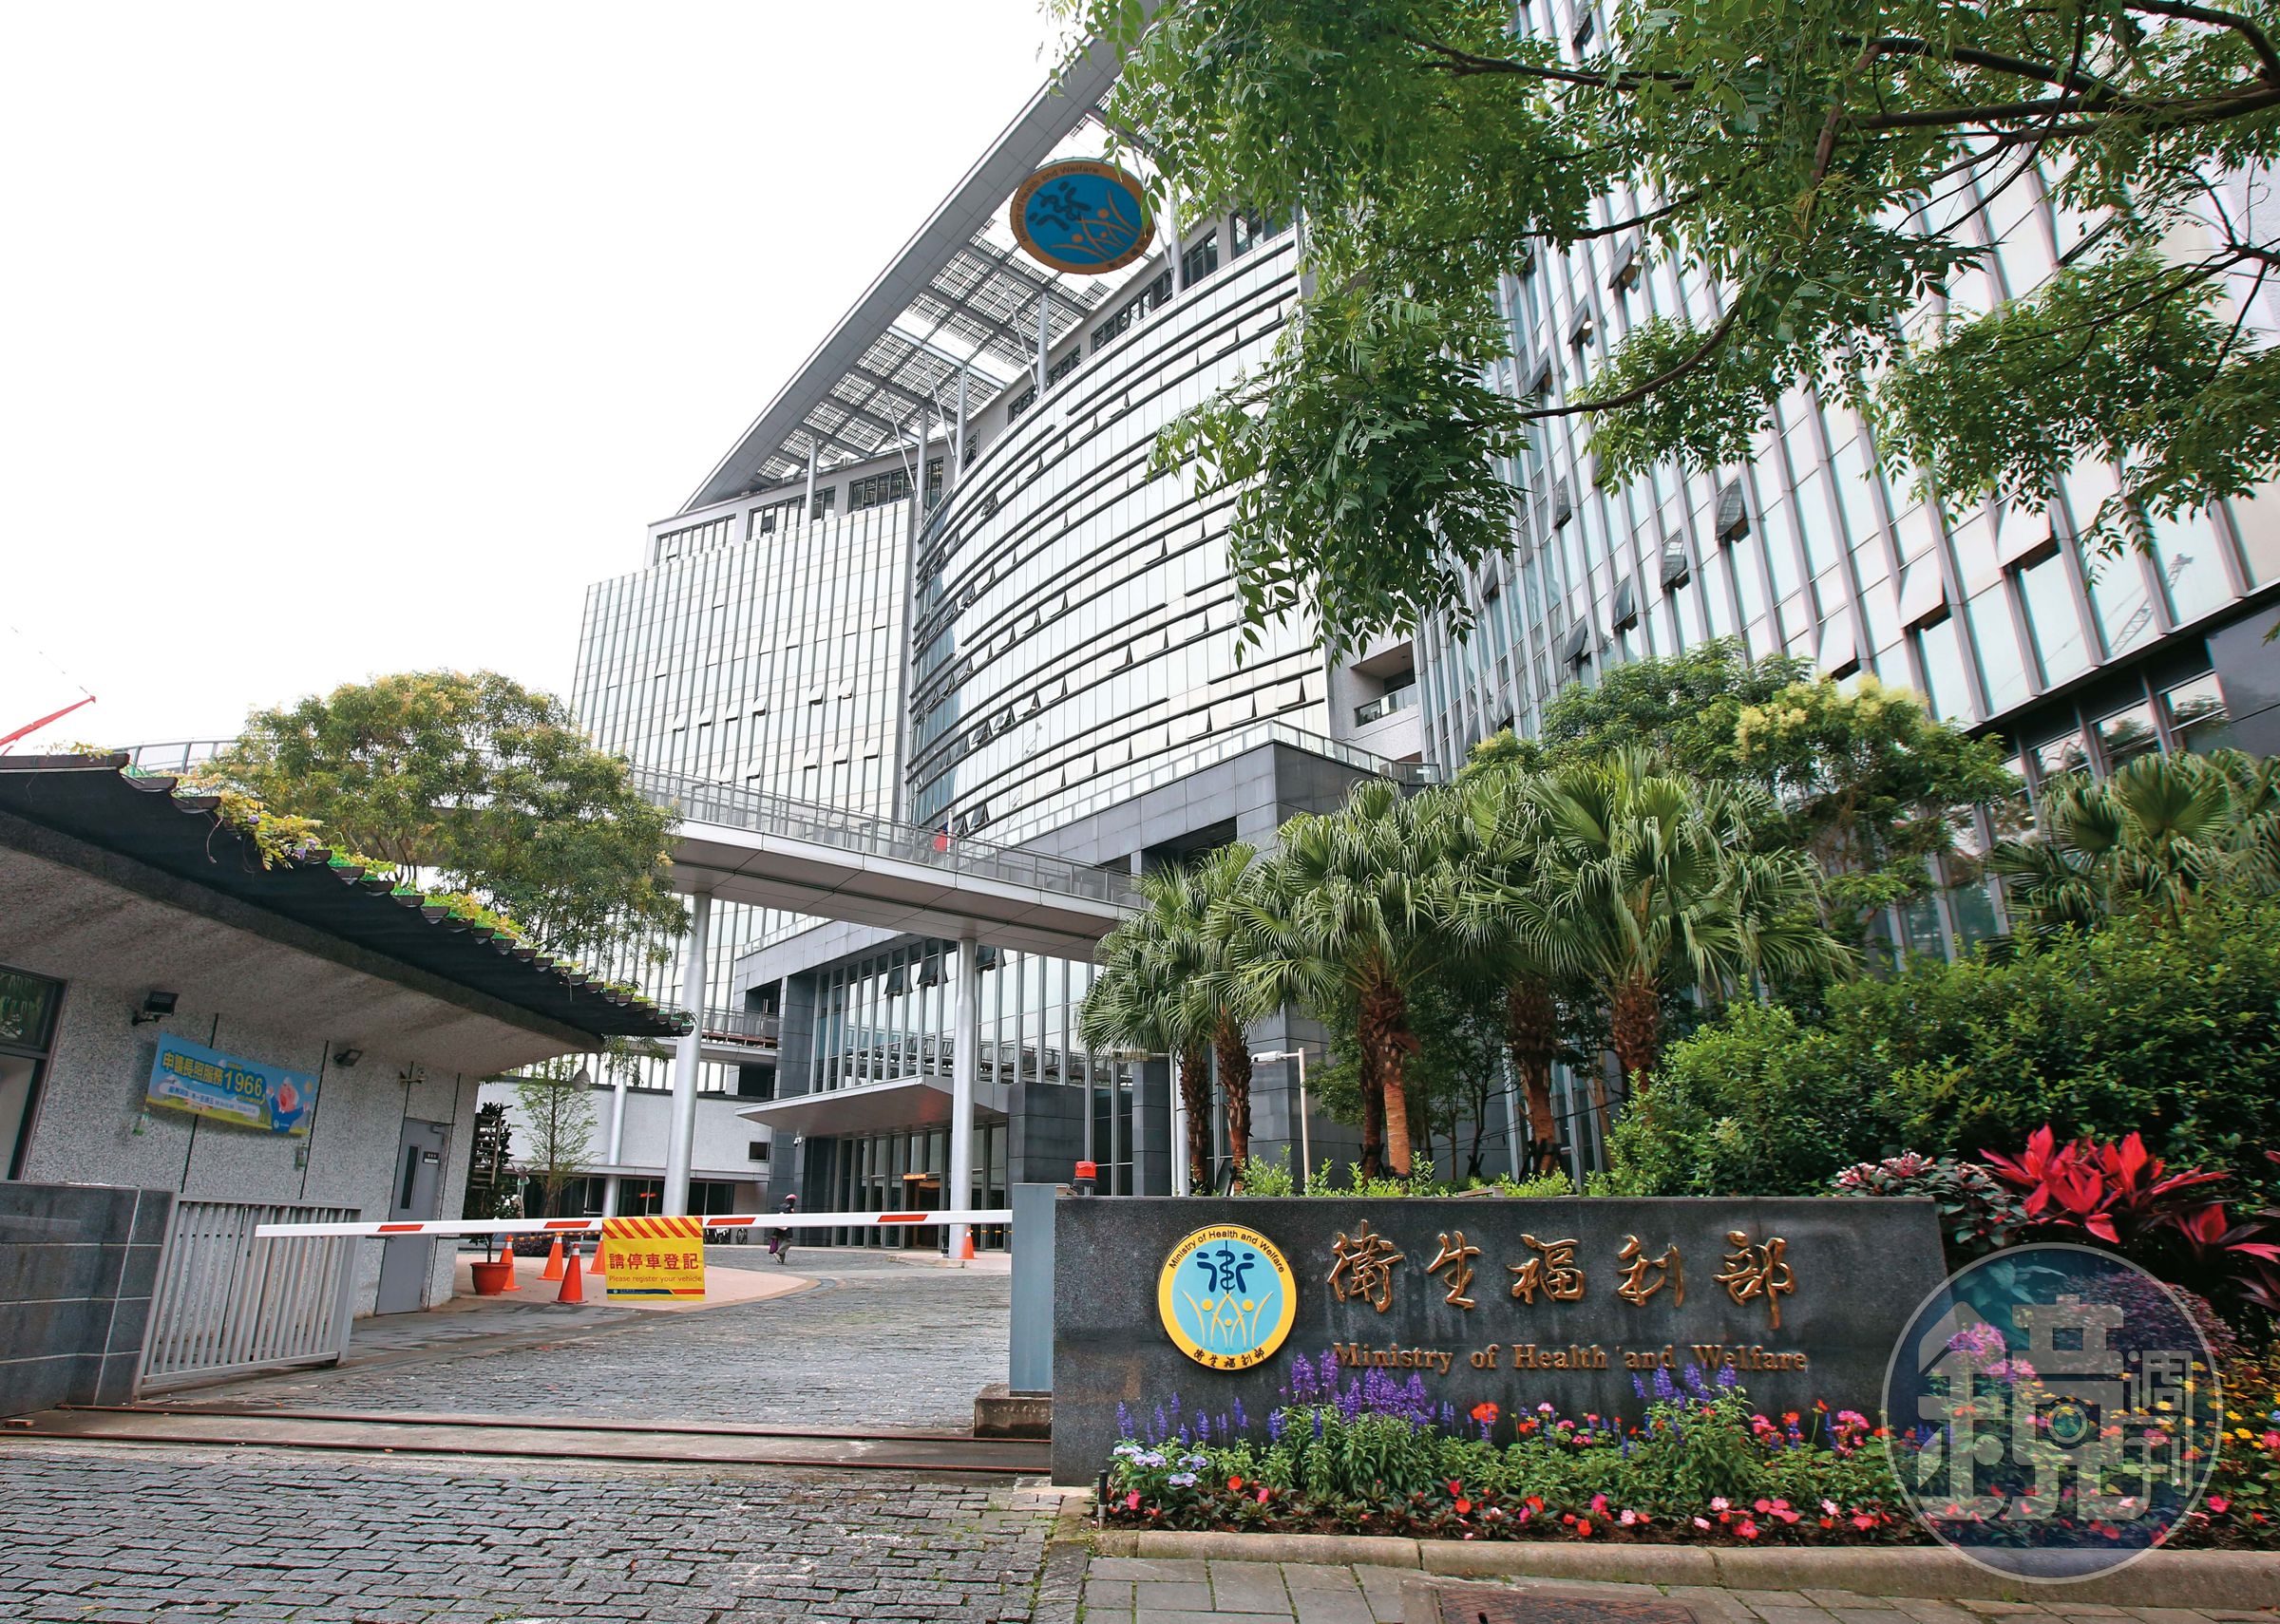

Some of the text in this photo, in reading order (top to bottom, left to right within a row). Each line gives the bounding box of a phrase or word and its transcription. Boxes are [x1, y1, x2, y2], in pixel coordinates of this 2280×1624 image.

[1041, 169, 1058, 181] and
[1060, 165, 1100, 174] Welfare
[224, 1070, 264, 1096] 1966
[609, 1253, 699, 1270] 請停車登記
[1168, 1230, 1285, 1274] Ministry of Health and Welfare
[632, 1275, 658, 1284] register
[1326, 1218, 1796, 1330] 衛生福利部
[1193, 1347, 1265, 1368] 衛生福利部
[1332, 1342, 1809, 1375] Ministry of Health and Welfare
